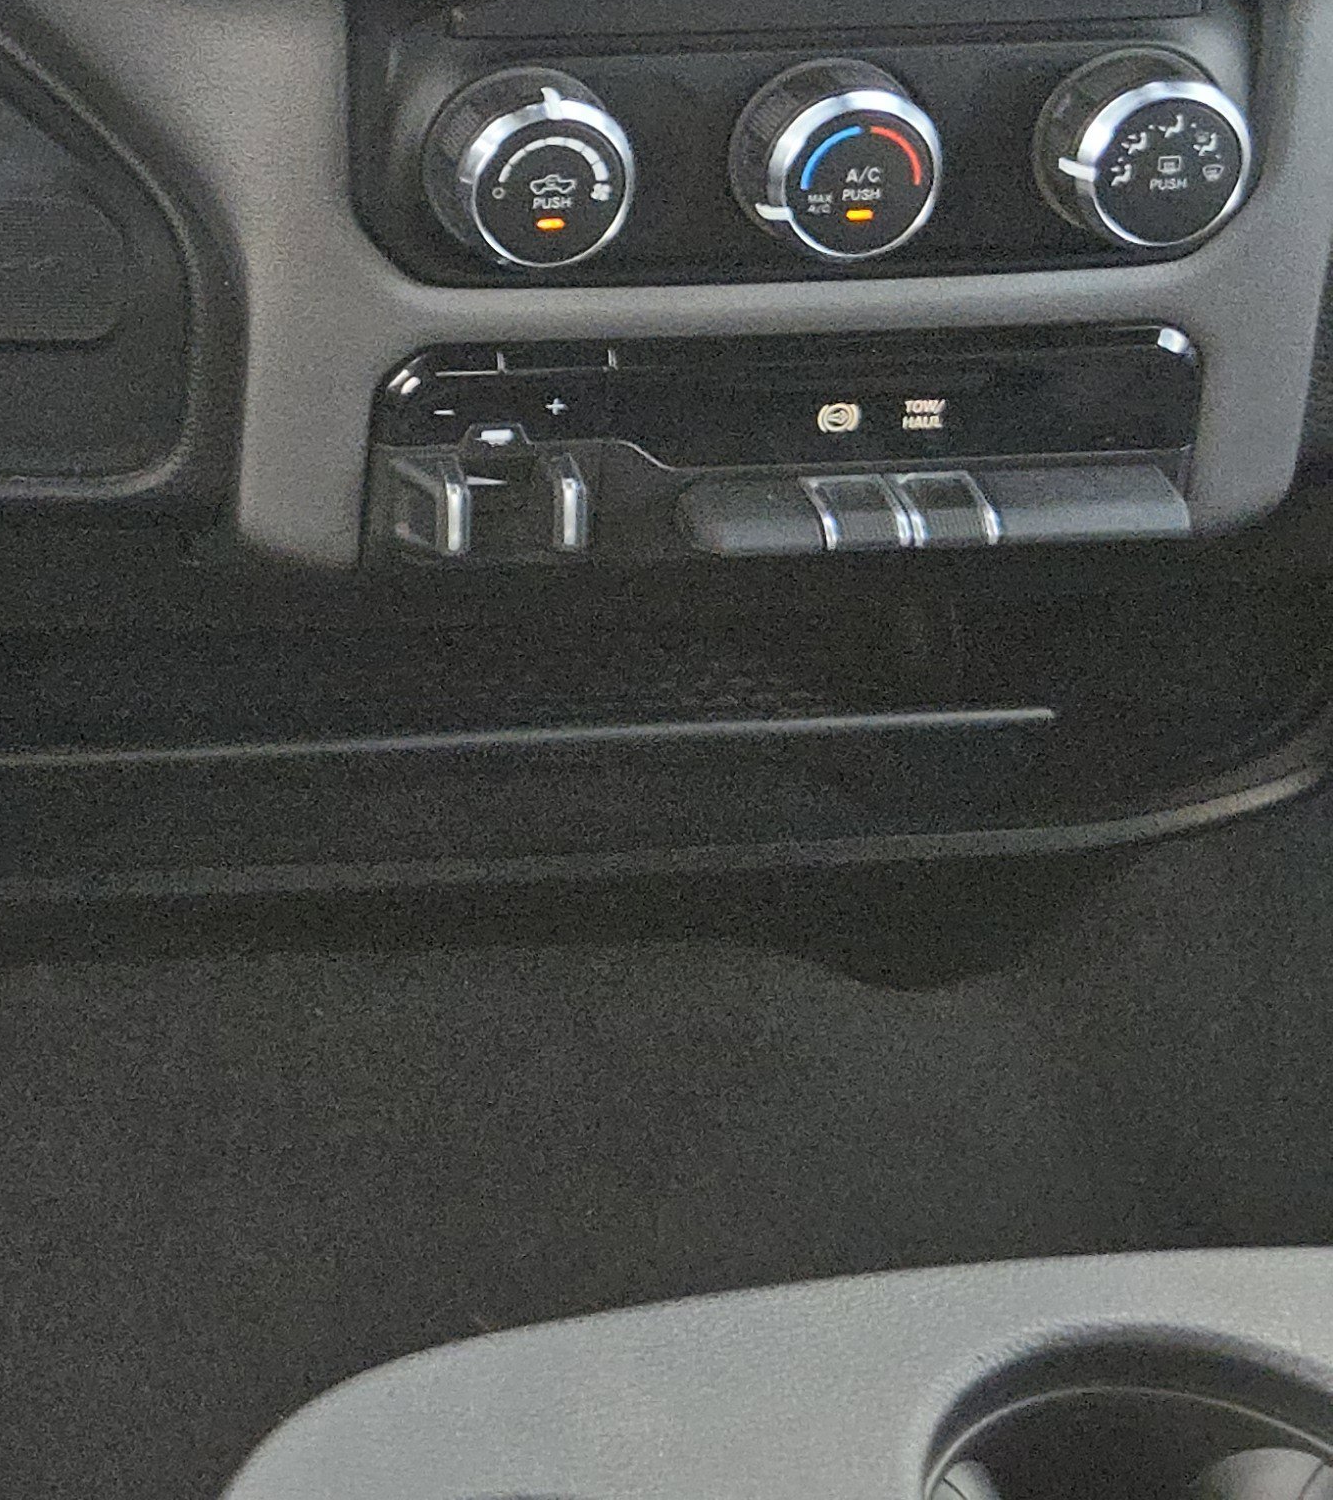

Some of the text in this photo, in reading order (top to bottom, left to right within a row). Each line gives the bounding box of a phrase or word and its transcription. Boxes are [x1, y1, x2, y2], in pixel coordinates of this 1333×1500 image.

[845, 165, 881, 184] A/C
[1150, 178, 1188, 191] PUSH
[842, 187, 881, 201] PUSH
[533, 196, 572, 210] PUSH
[902, 415, 944, 429] HAUL
